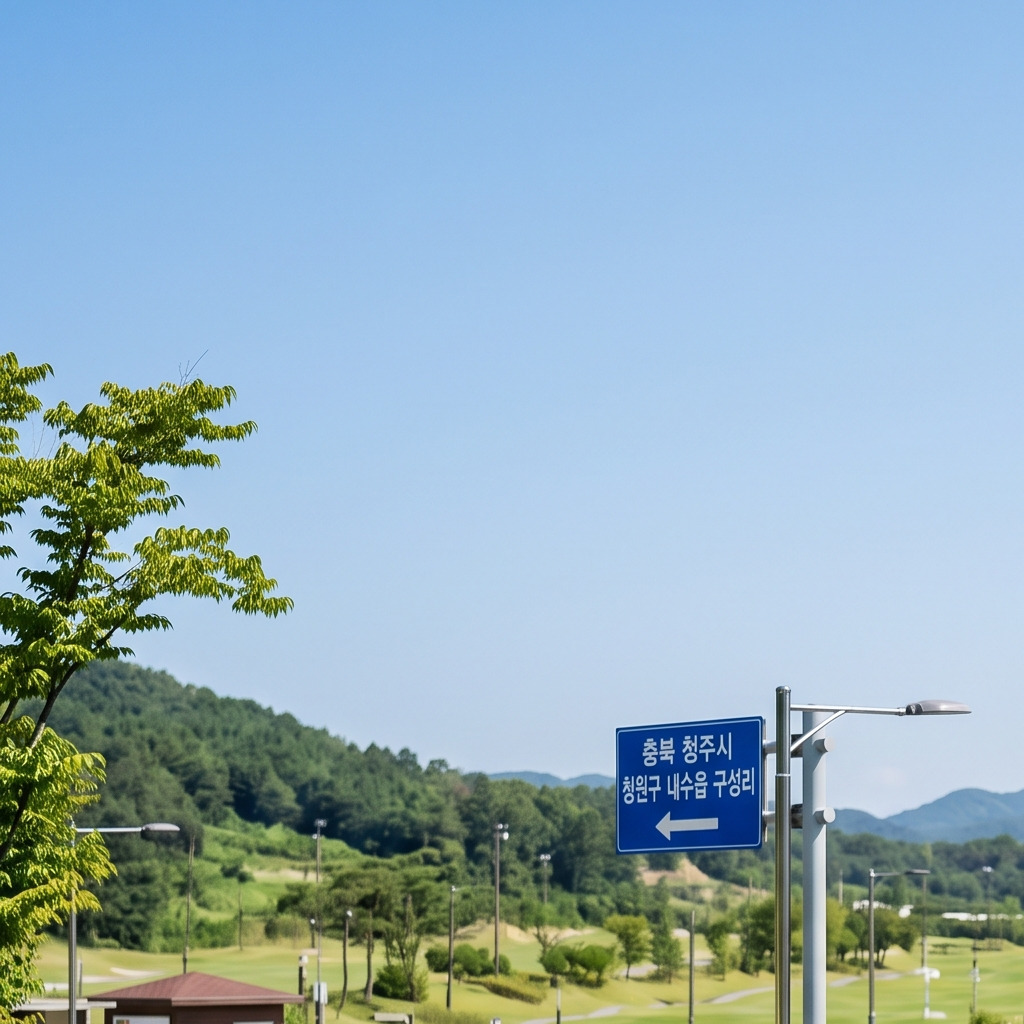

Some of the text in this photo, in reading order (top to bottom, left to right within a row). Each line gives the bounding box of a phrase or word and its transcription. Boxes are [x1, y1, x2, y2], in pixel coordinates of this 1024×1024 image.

[642, 732, 732, 767] 충북 청주시
[622, 767, 755, 805] 청원구 내수읍 구성리
